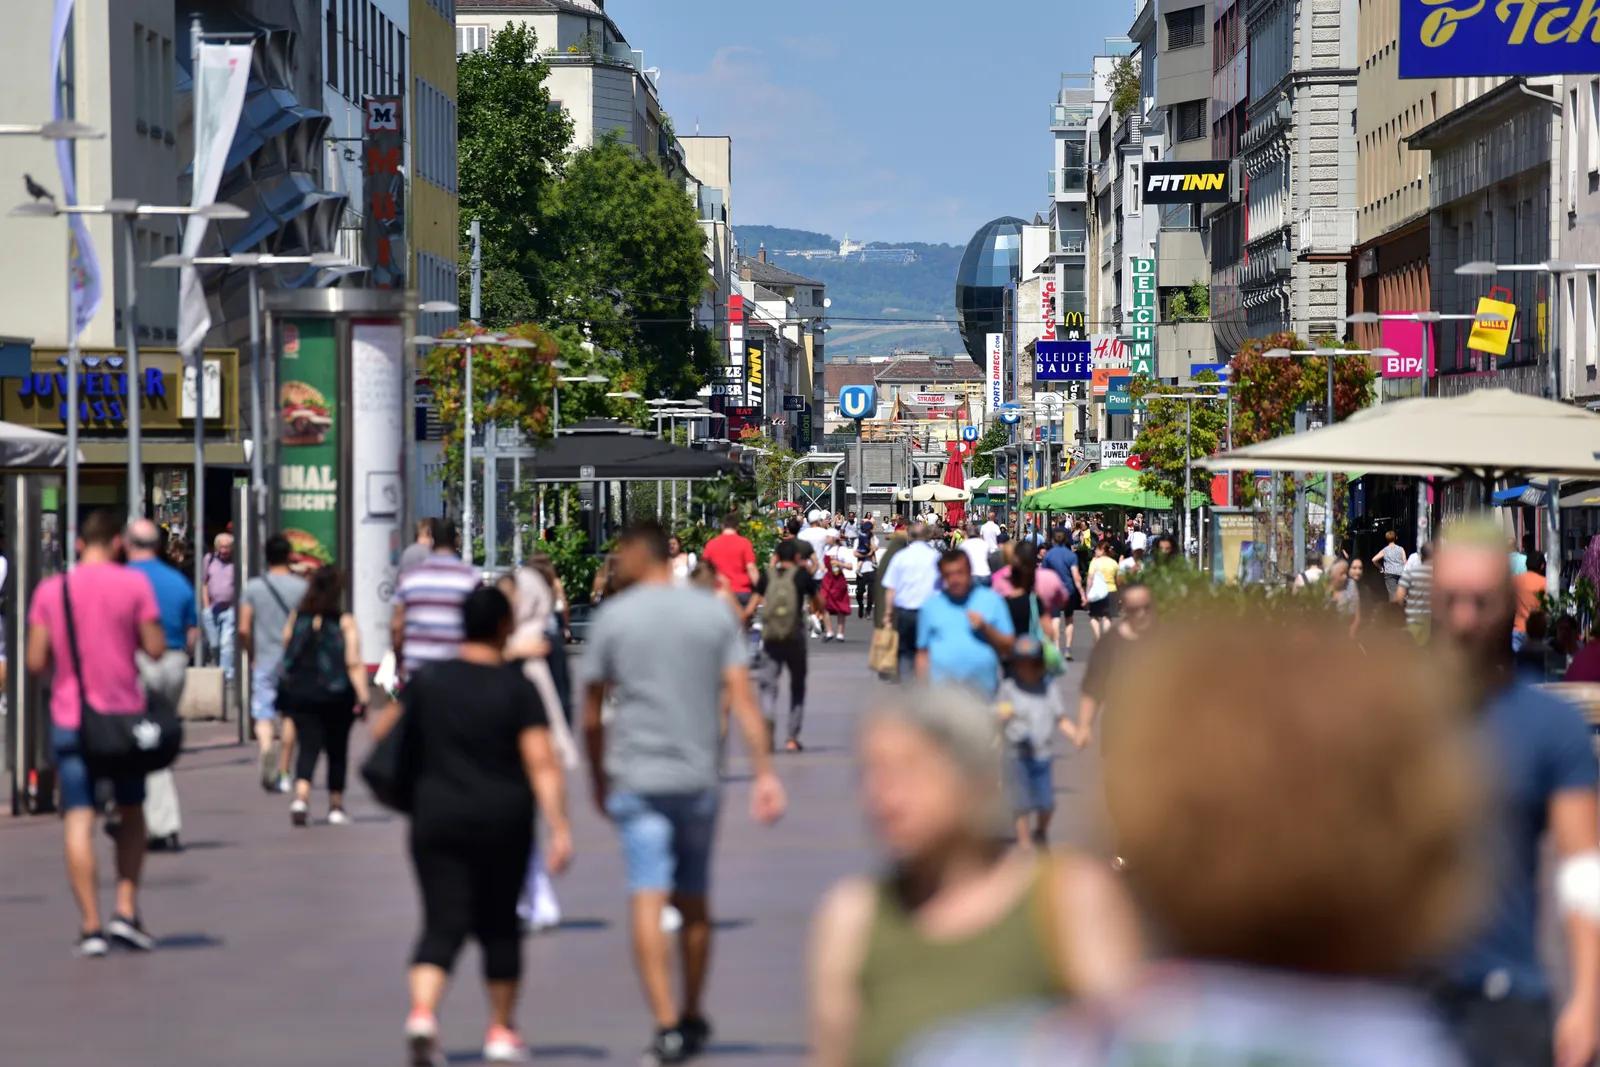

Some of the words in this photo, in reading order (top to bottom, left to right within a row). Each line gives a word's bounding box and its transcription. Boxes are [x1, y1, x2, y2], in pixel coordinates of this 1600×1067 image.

[374, 108, 392, 122] M
[1147, 173, 1225, 191] FITINN
[1481, 319, 1506, 328] BILLA
[1094, 338, 1124, 359] H&M
[1036, 363, 1093, 373] BAUER
[845, 393, 865, 415] U
[965, 430, 975, 439] U
[1111, 442, 1129, 450] STAR
